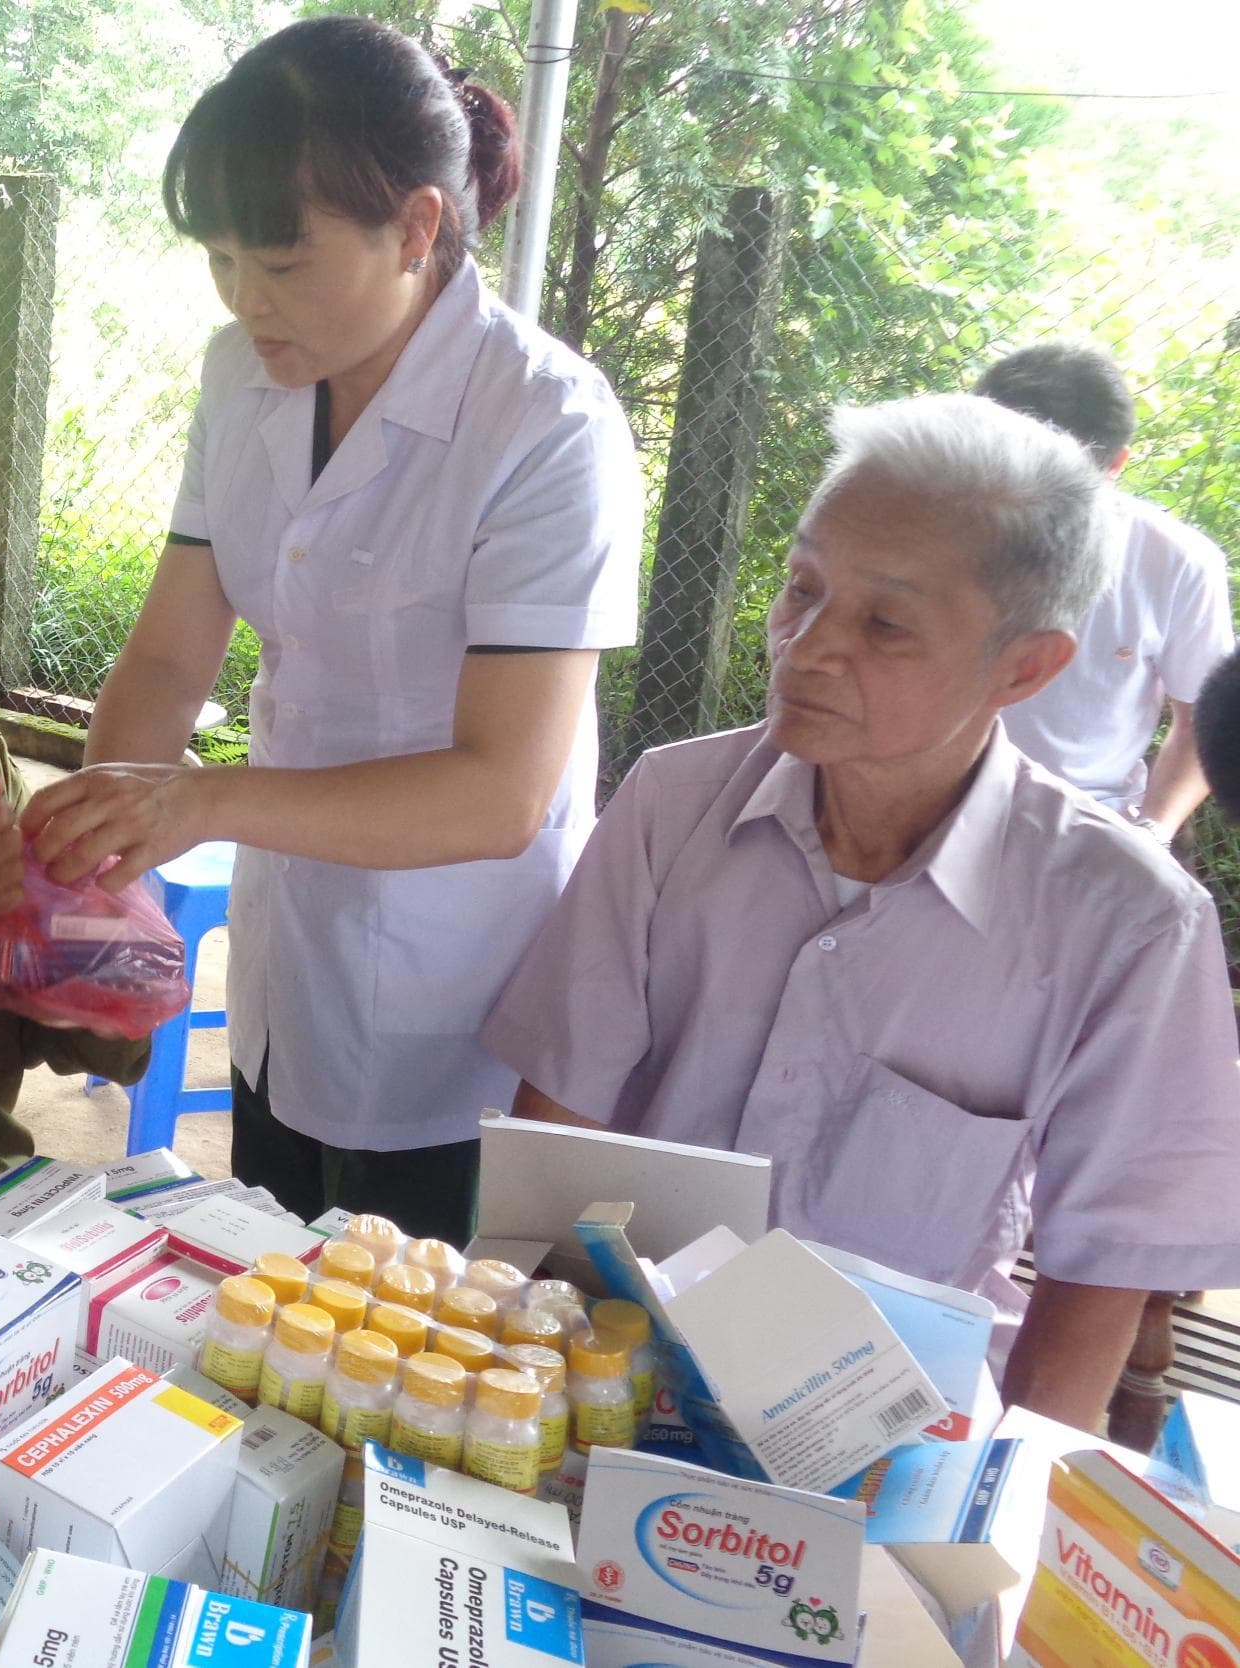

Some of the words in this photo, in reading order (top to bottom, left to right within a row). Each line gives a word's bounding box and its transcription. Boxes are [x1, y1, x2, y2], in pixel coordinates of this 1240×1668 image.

[32, 1173, 83, 1210] VINPOCETIN
[111, 1164, 136, 1177] 5mg
[10, 1202, 35, 1218] 5mg
[32, 1372, 54, 1400] 5g
[762, 1368, 832, 1422] Amoxicillin
[832, 1340, 876, 1376] 500mg
[13, 1397, 113, 1465] CEPHALEXIN
[108, 1371, 152, 1400] 500mg
[974, 1490, 992, 1506] GMP
[983, 1467, 1000, 1484] WHO
[380, 1494, 438, 1522] Capsules
[440, 1515, 466, 1530] USP
[380, 1481, 453, 1514] Omeprazole
[456, 1508, 560, 1551] Delayed-Release
[661, 1507, 801, 1572] Sorbitol
[36, 1580, 48, 1596] GMP
[44, 1558, 56, 1574] WHO
[435, 1558, 458, 1640] Capsules
[755, 1564, 793, 1598] 5g
[1051, 1531, 1169, 1654] Vitamin
[464, 1567, 488, 1668] Omeprazol
[508, 1579, 524, 1632] Brawn
[34, 1628, 68, 1668] 5mg
[195, 1600, 231, 1658] Brawn
